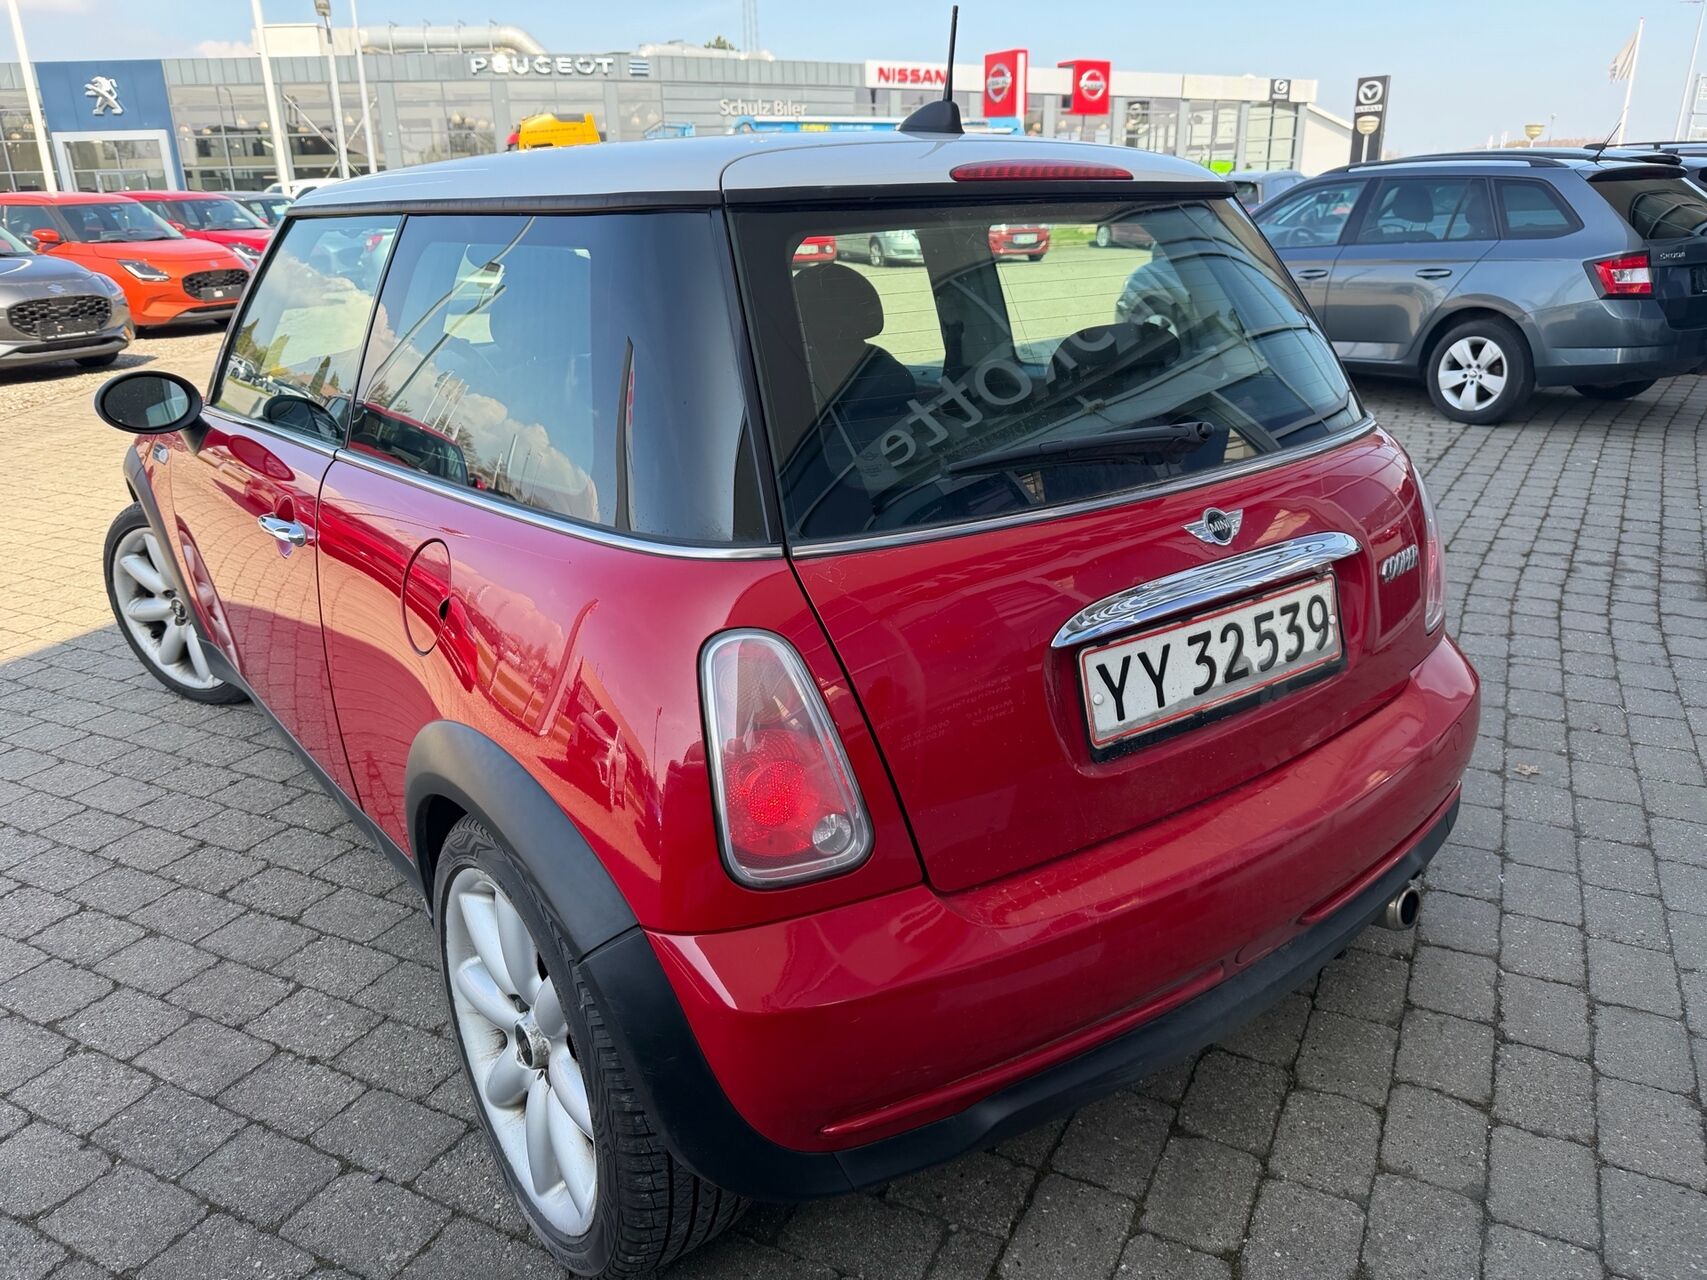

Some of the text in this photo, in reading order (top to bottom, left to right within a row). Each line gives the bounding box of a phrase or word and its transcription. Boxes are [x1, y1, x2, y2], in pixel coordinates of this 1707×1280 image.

[469, 54, 615, 75] PEUGEOT
[878, 67, 949, 85] NISSAN
[719, 98, 808, 117] Schulz Biler
[1209, 519, 1231, 533] MINI
[1095, 643, 1171, 721] YY
